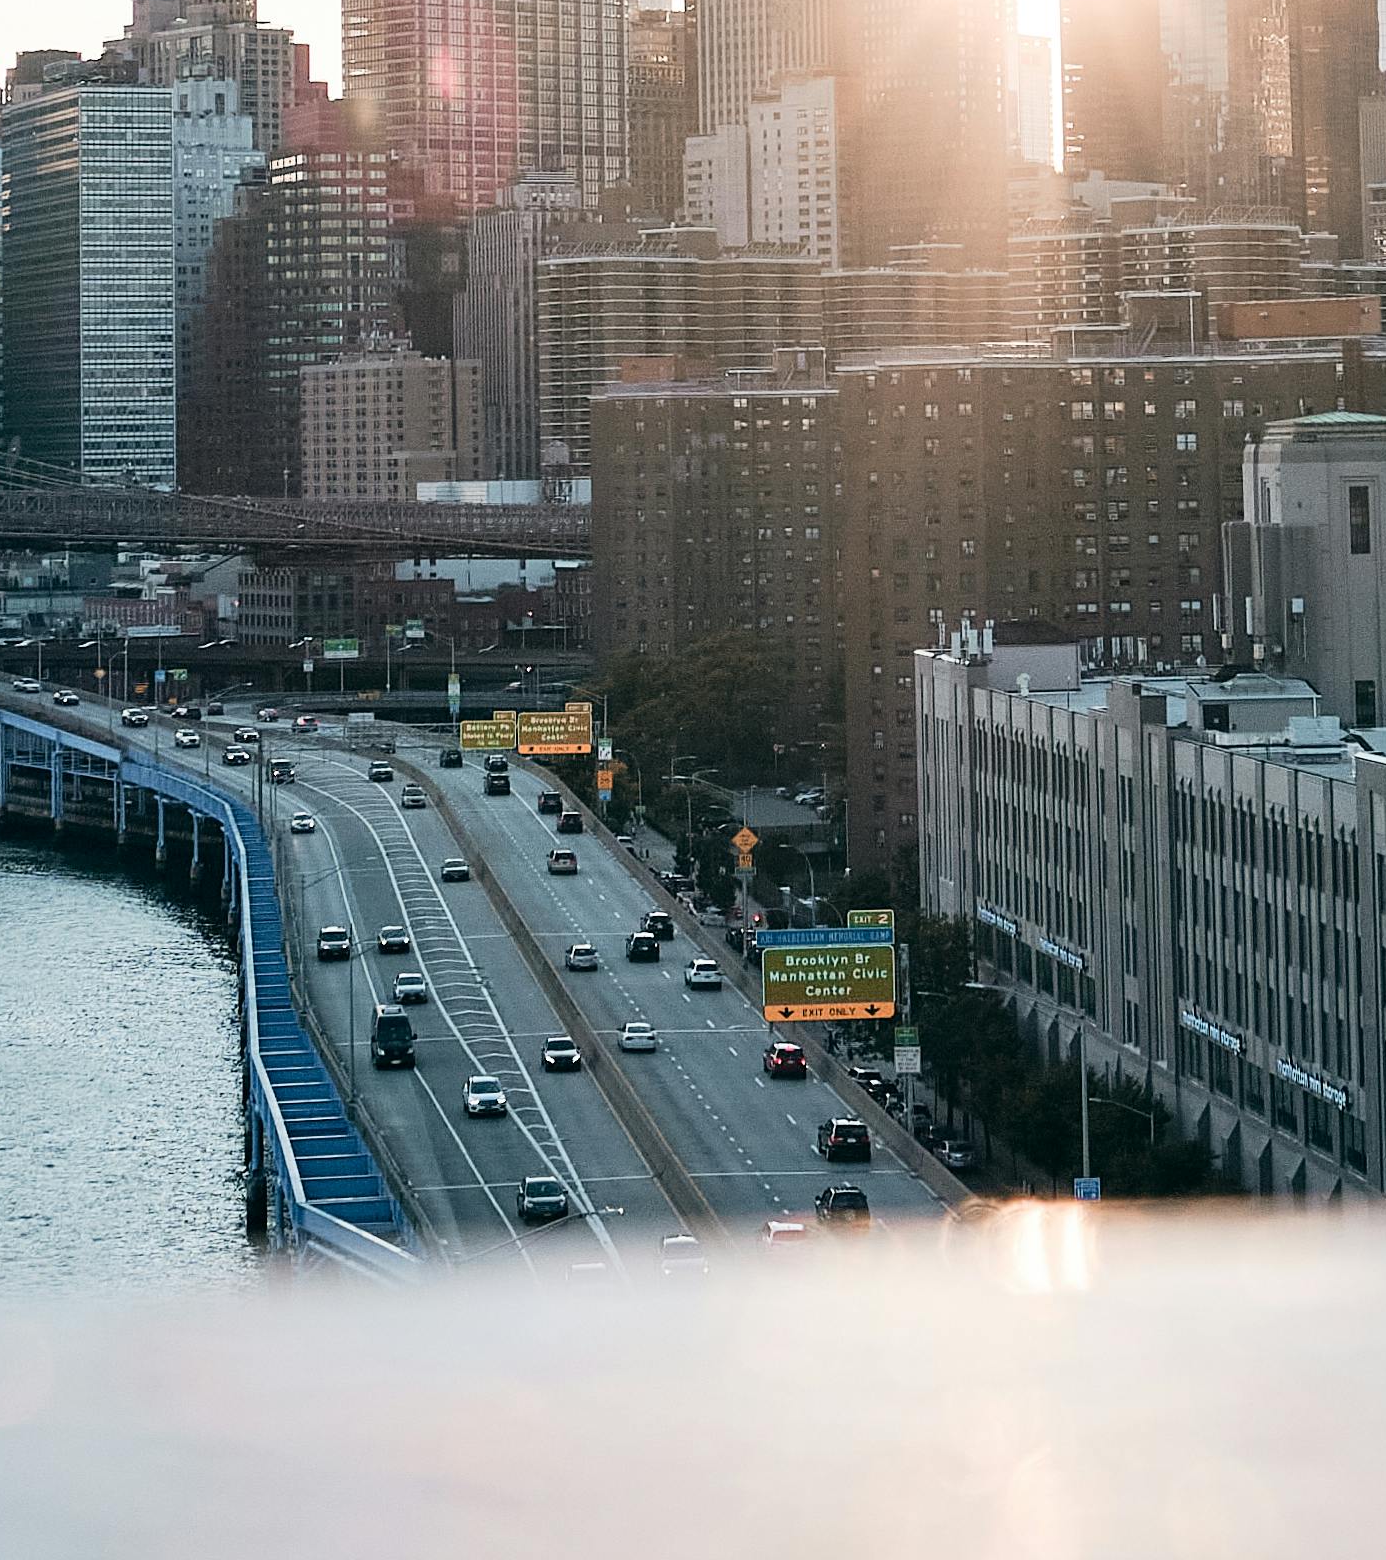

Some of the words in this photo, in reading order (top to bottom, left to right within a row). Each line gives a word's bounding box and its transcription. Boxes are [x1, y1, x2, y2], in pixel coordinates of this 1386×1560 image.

[854, 915, 872, 924] EXIT
[877, 913, 889, 924] 2
[785, 954, 848, 967] Brooklyn
[855, 953, 871, 964] Br
[769, 969, 846, 982] Manhattan
[852, 967, 888, 979] Civic
[805, 984, 853, 997] Center
[802, 1007, 824, 1017] EXIT
[829, 1006, 856, 1016] ONLY
